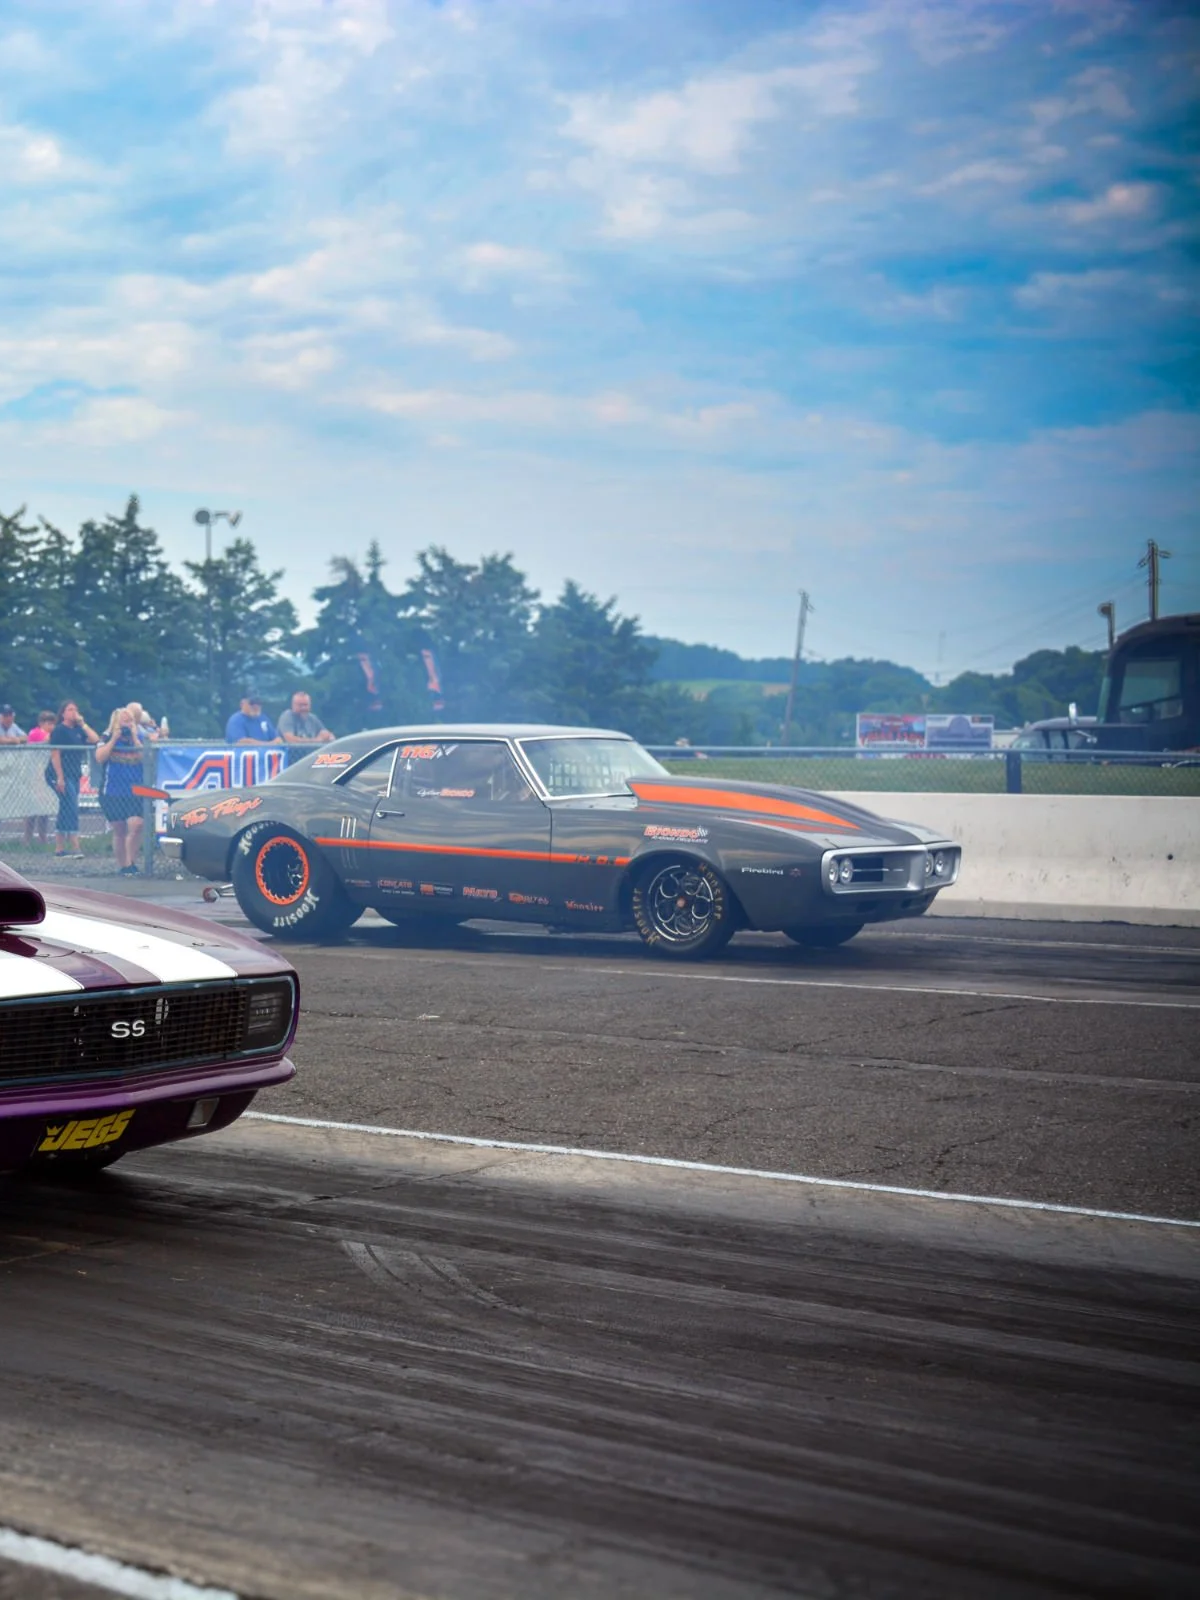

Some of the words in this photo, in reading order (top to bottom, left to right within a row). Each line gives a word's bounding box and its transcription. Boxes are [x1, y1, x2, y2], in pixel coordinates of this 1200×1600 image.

[741, 867, 784, 875] Firebird
[111, 1019, 146, 1039] SS
[38, 1109, 136, 1152] JEGS
